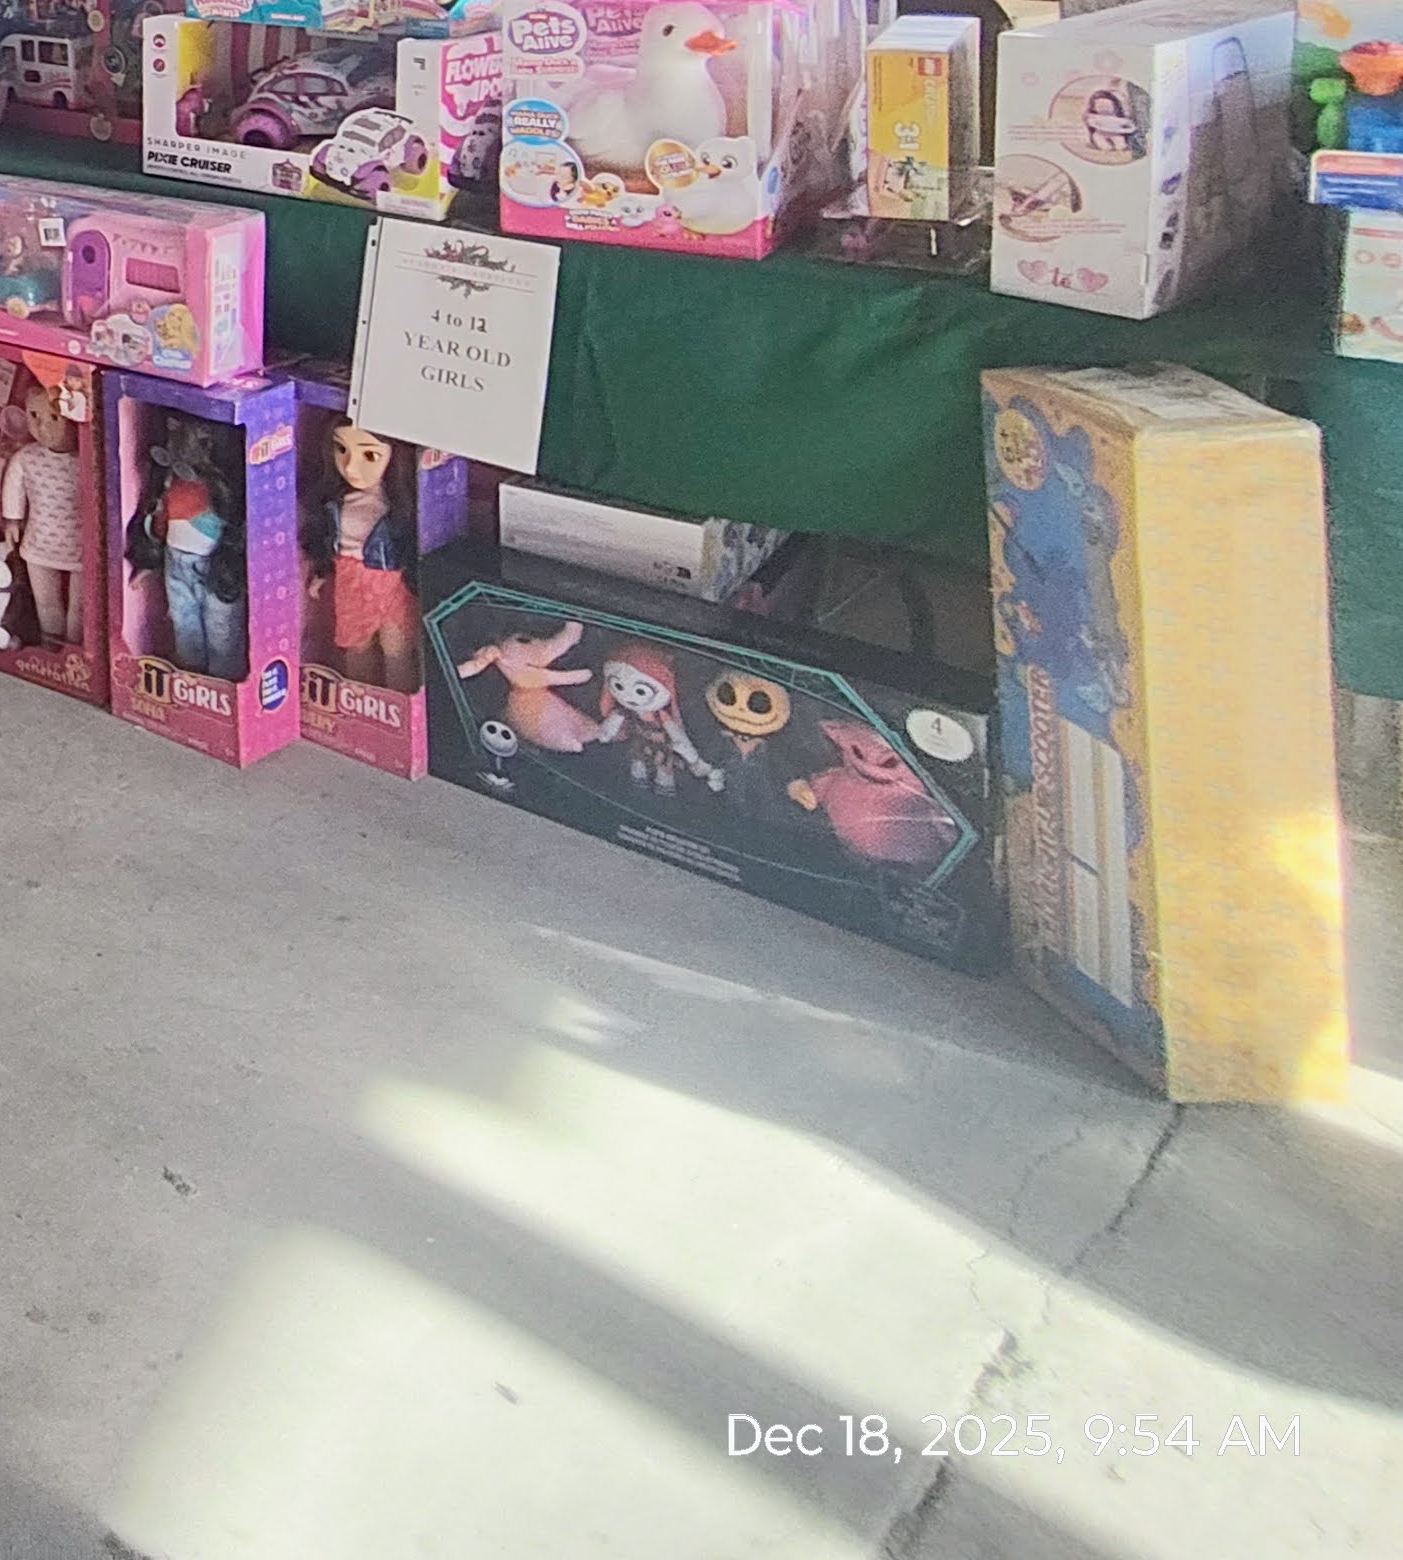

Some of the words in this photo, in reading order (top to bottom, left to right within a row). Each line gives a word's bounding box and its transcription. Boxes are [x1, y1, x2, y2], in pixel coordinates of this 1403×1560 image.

[511, 17, 577, 44] Pets
[522, 33, 574, 52] Alive
[513, 116, 558, 130] REALLY
[146, 136, 202, 153] SHARPER
[206, 145, 247, 160] IMAGE
[146, 151, 179, 167] PIXIE
[180, 154, 233, 175] CRUISER
[446, 312, 463, 327] to
[470, 316, 488, 333] 12
[403, 330, 461, 358] YEAR
[466, 344, 512, 368] OLD
[420, 365, 485, 392] GIRLS
[929, 716, 943, 736] 4
